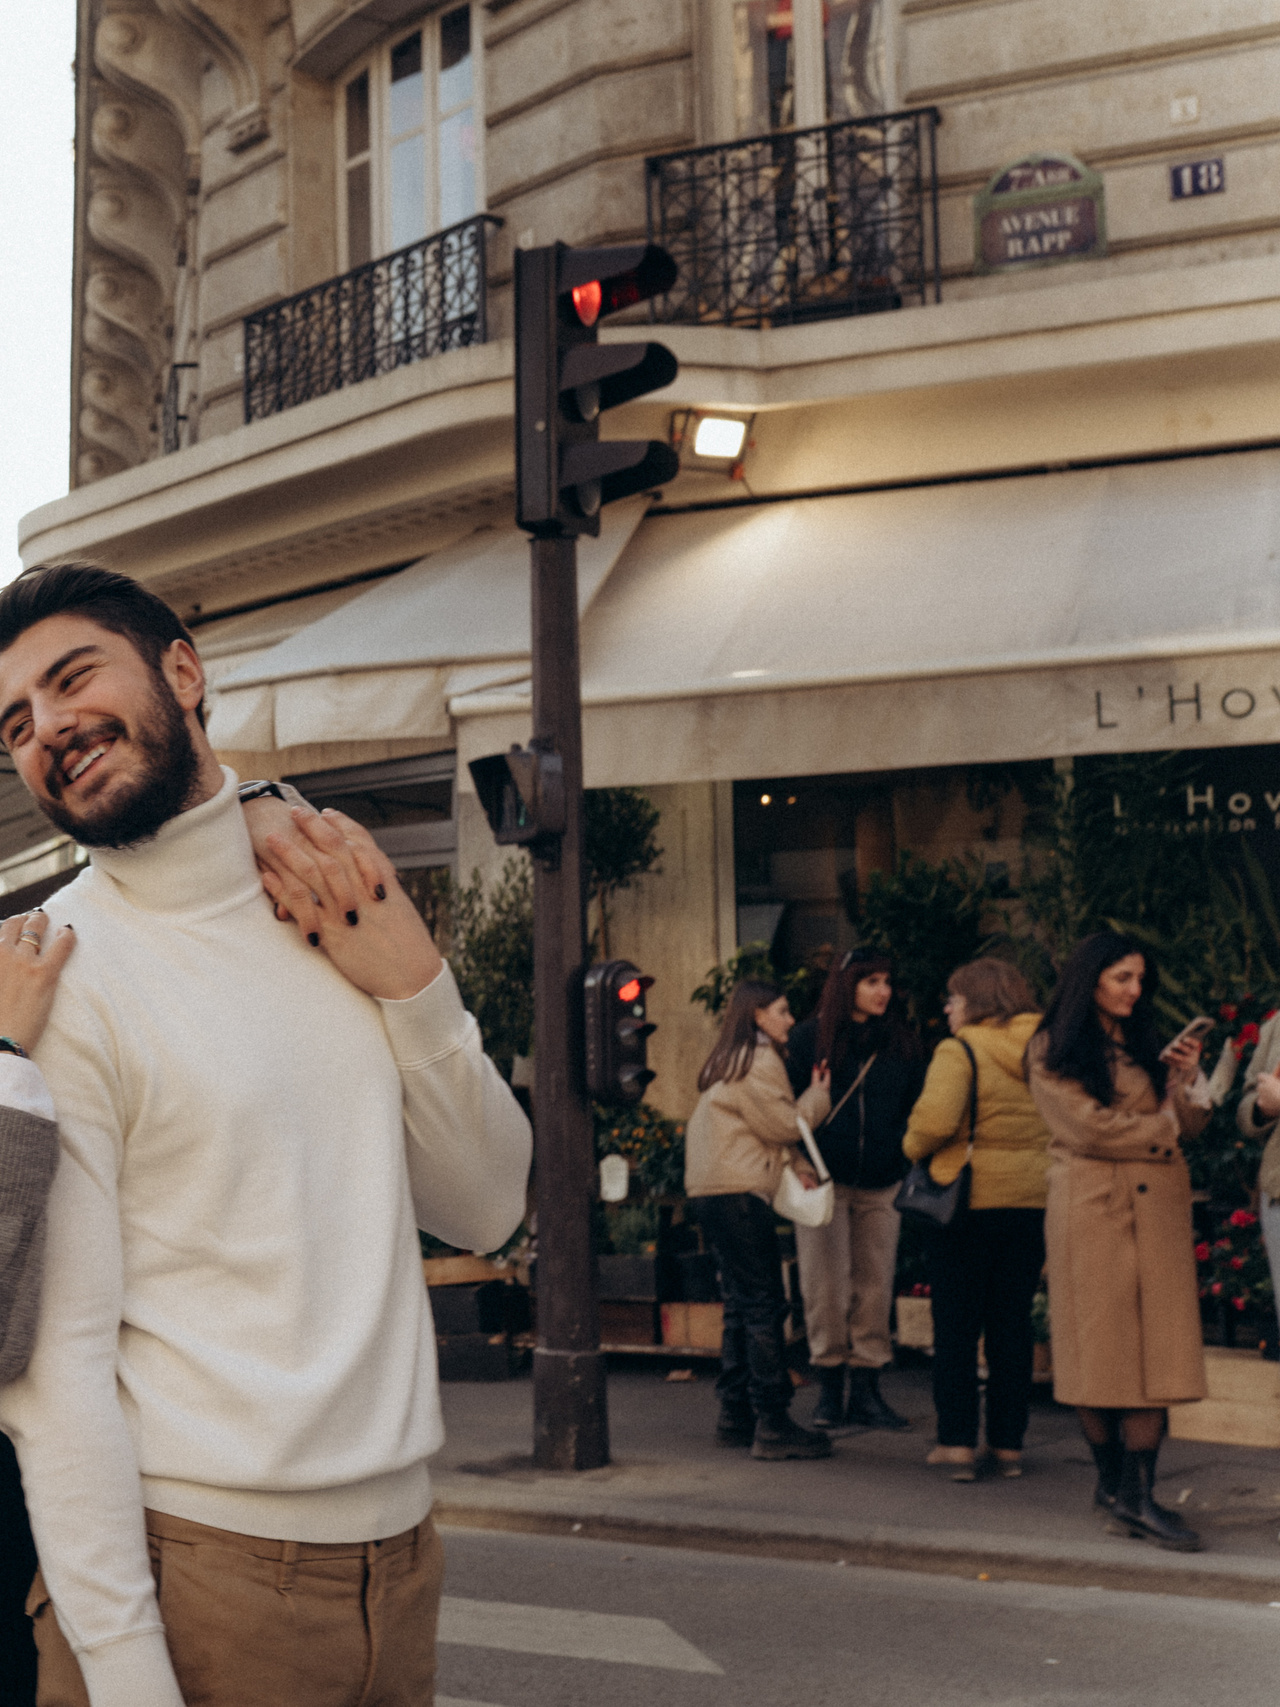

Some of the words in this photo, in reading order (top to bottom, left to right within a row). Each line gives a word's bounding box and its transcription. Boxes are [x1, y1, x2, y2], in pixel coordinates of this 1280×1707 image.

[1181, 163, 1221, 195] 18
[999, 205, 1081, 235] AVENUE
[1006, 230, 1072, 258] RAPP
[1095, 682, 1280, 729] L'HO
